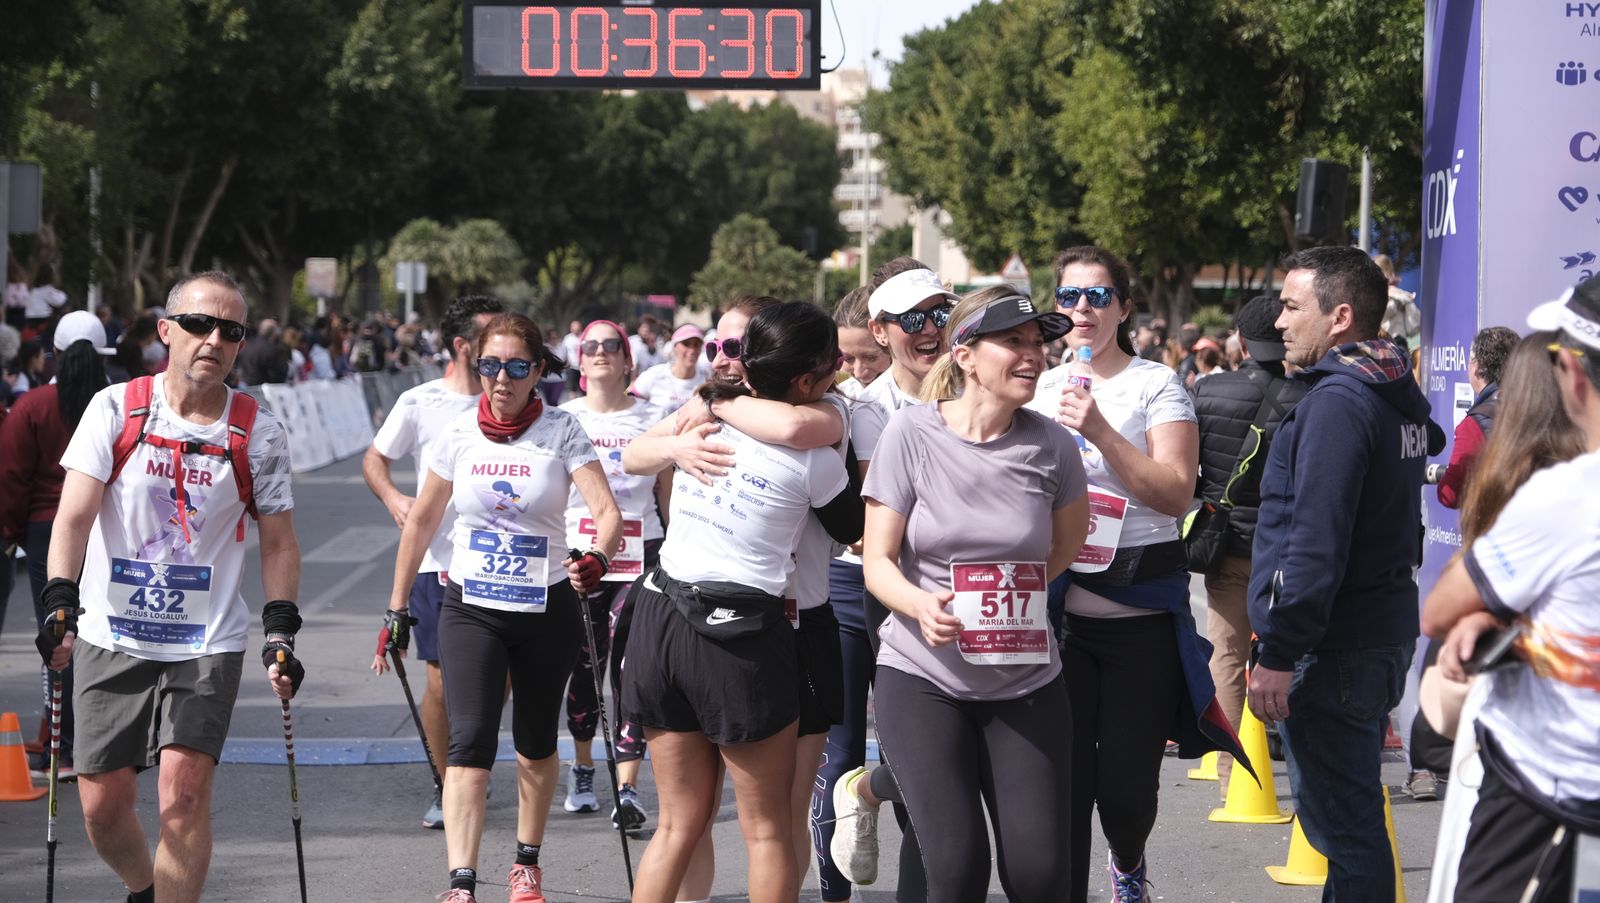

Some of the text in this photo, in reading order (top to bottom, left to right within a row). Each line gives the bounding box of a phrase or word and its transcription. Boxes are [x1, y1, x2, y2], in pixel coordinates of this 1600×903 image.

[521, 6, 803, 78] 00:36:30
[1427, 167, 1457, 239] CDX
[1431, 340, 1467, 372] ALMERÍA
[471, 463, 532, 477] MUJER
[123, 569, 146, 578] MUJER
[481, 554, 528, 577] 322
[129, 587, 185, 613] 432
[980, 591, 1031, 618] 517
[124, 609, 148, 618] JESUS
[150, 612, 188, 621] LOGALUVI
[713, 607, 736, 619] NIKE
